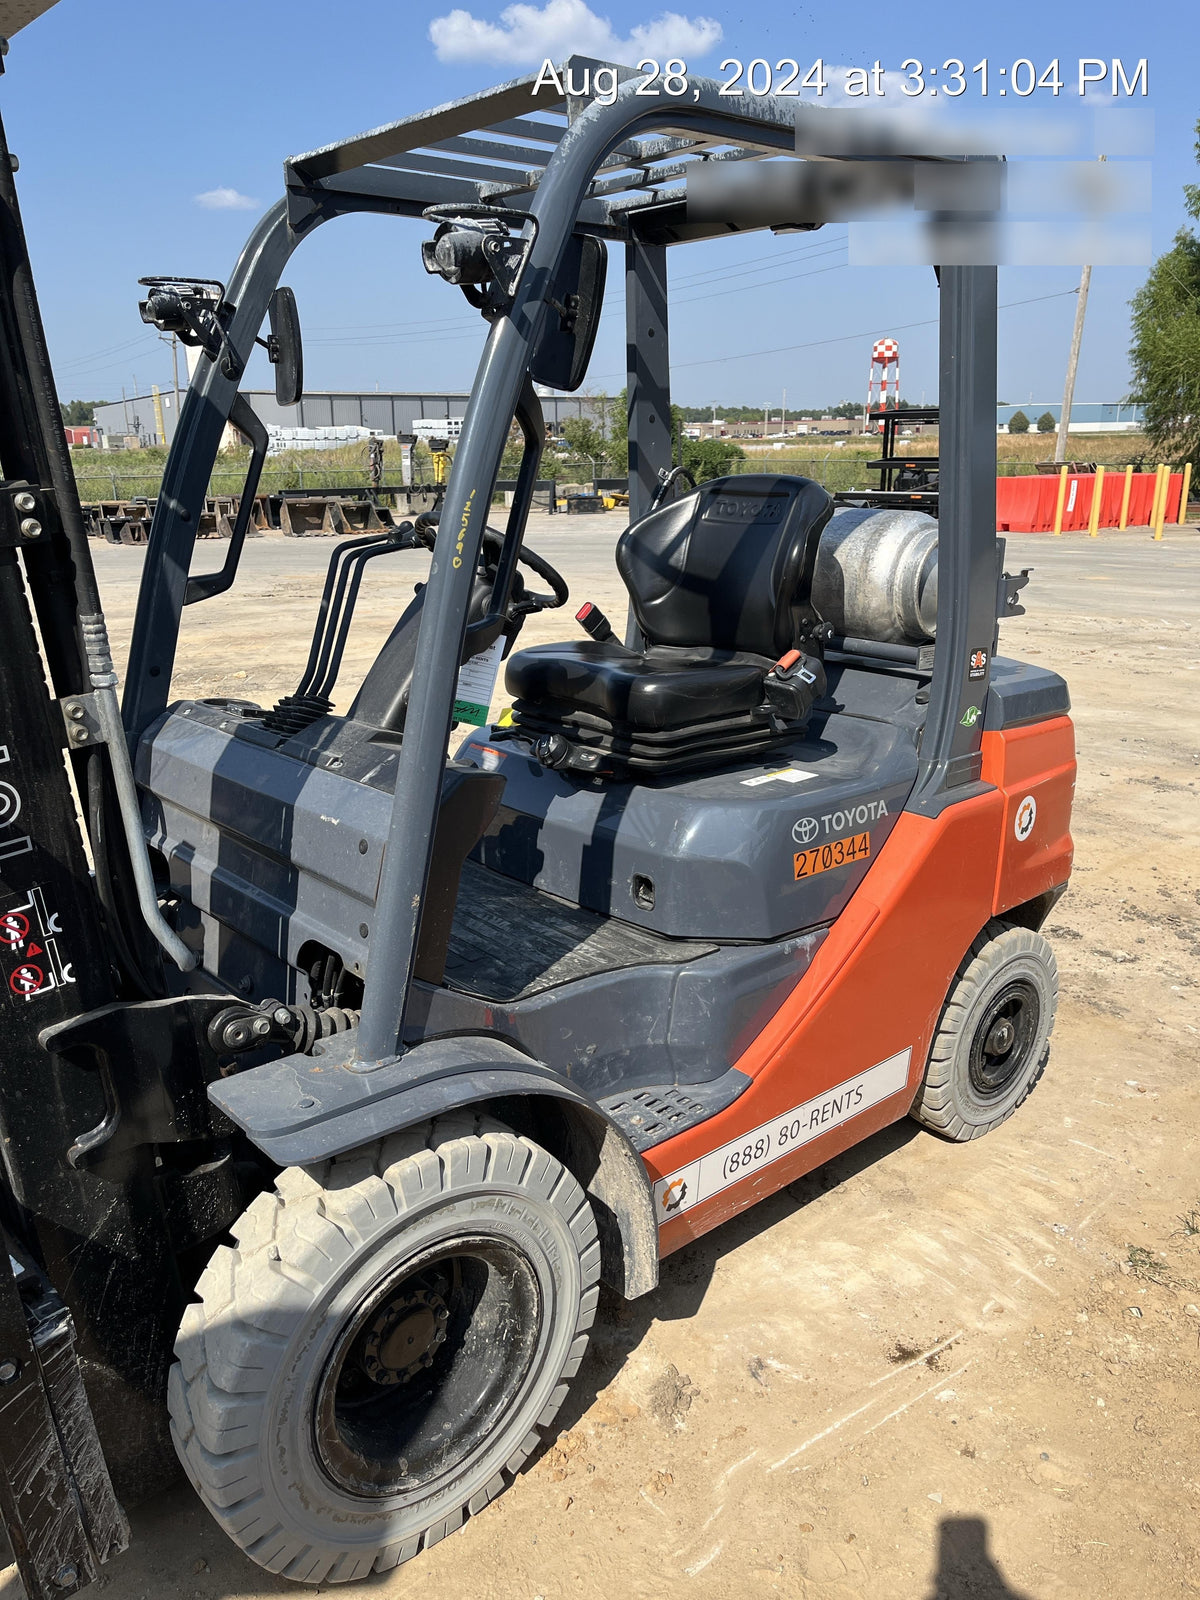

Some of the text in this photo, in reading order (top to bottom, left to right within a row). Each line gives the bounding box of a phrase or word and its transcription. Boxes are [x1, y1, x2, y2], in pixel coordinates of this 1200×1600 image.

[715, 501, 782, 518] TOYOTA
[970, 650, 987, 669] SAS
[821, 799, 889, 834] TOYOTA
[796, 833, 869, 878] 270344
[722, 1084, 864, 1179] (888) 80-RENTS
